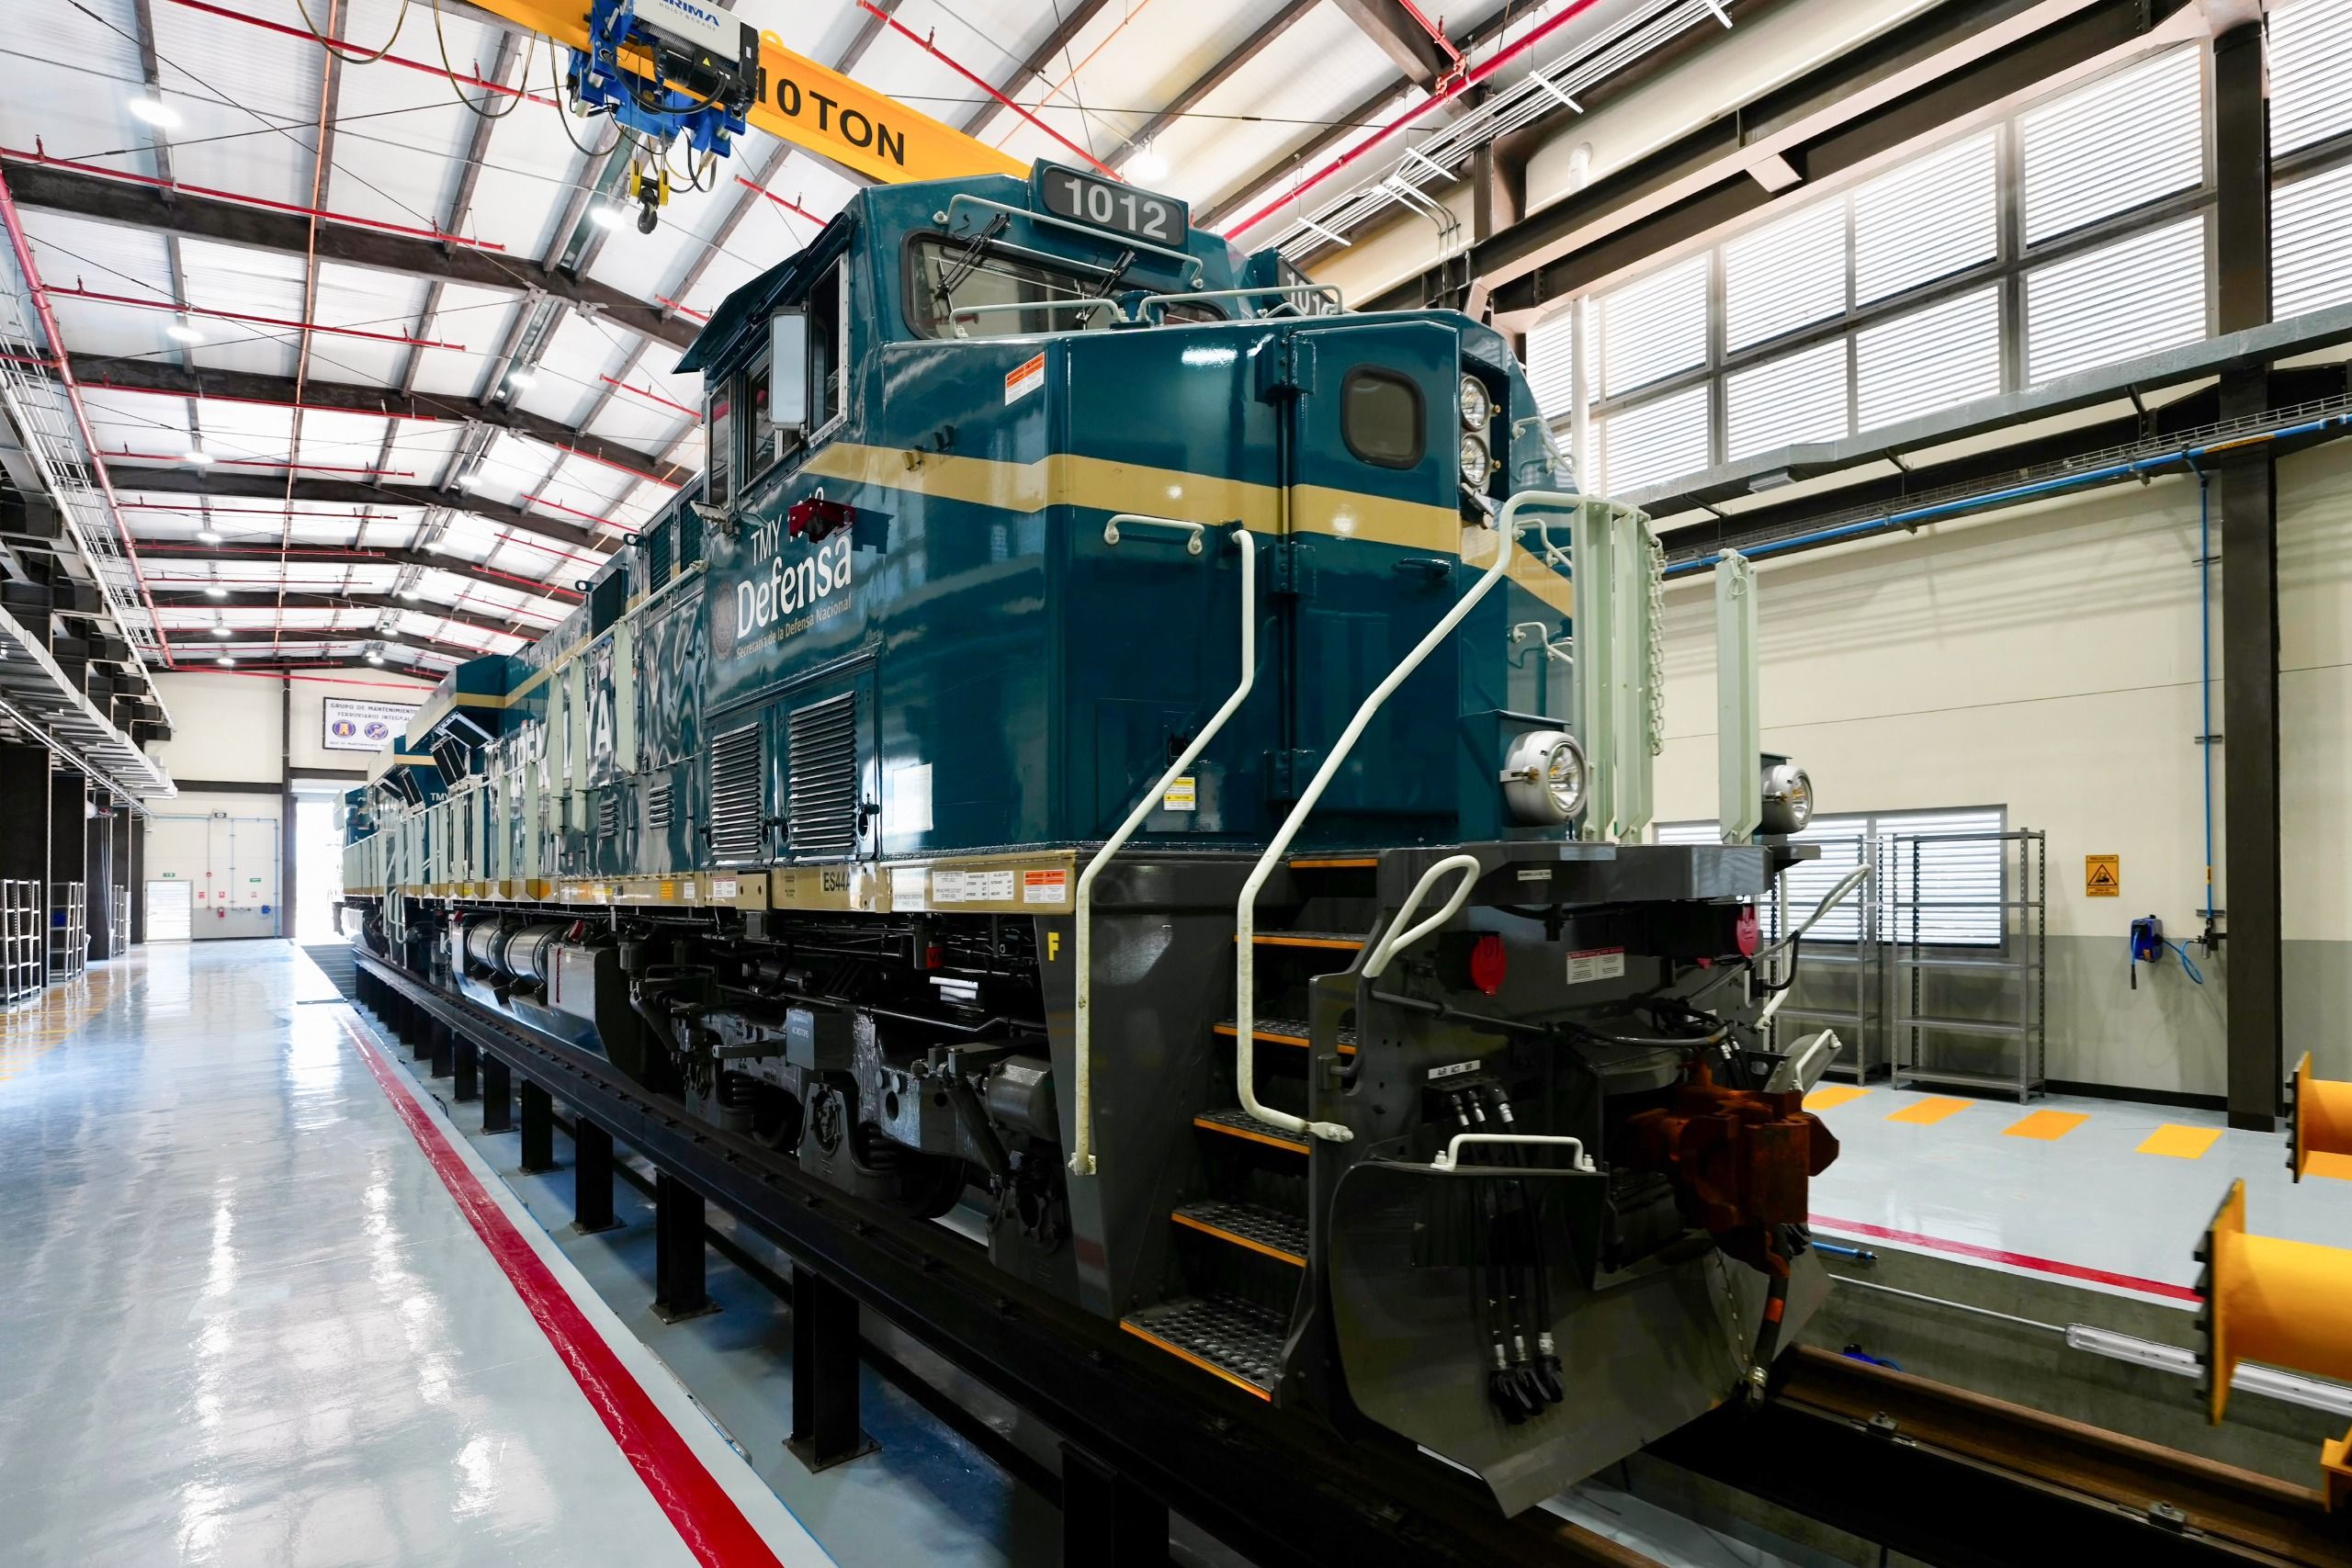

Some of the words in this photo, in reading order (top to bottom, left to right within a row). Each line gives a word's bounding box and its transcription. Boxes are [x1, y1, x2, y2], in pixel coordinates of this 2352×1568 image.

[662, 0, 720, 28] RIMA
[808, 90, 904, 166] TON
[1064, 178, 1167, 240] 1012
[1286, 271, 1334, 316] 101
[751, 514, 782, 567] TMY
[737, 536, 852, 639] Defensa
[768, 630, 776, 645] de
[777, 626, 785, 641] la
[785, 615, 815, 637] Defensa
[816, 592, 852, 622] Nacional
[330, 702, 355, 711] GRUPO
[337, 711, 379, 719] FERROVIARIO
[1047, 931, 1060, 962] F
